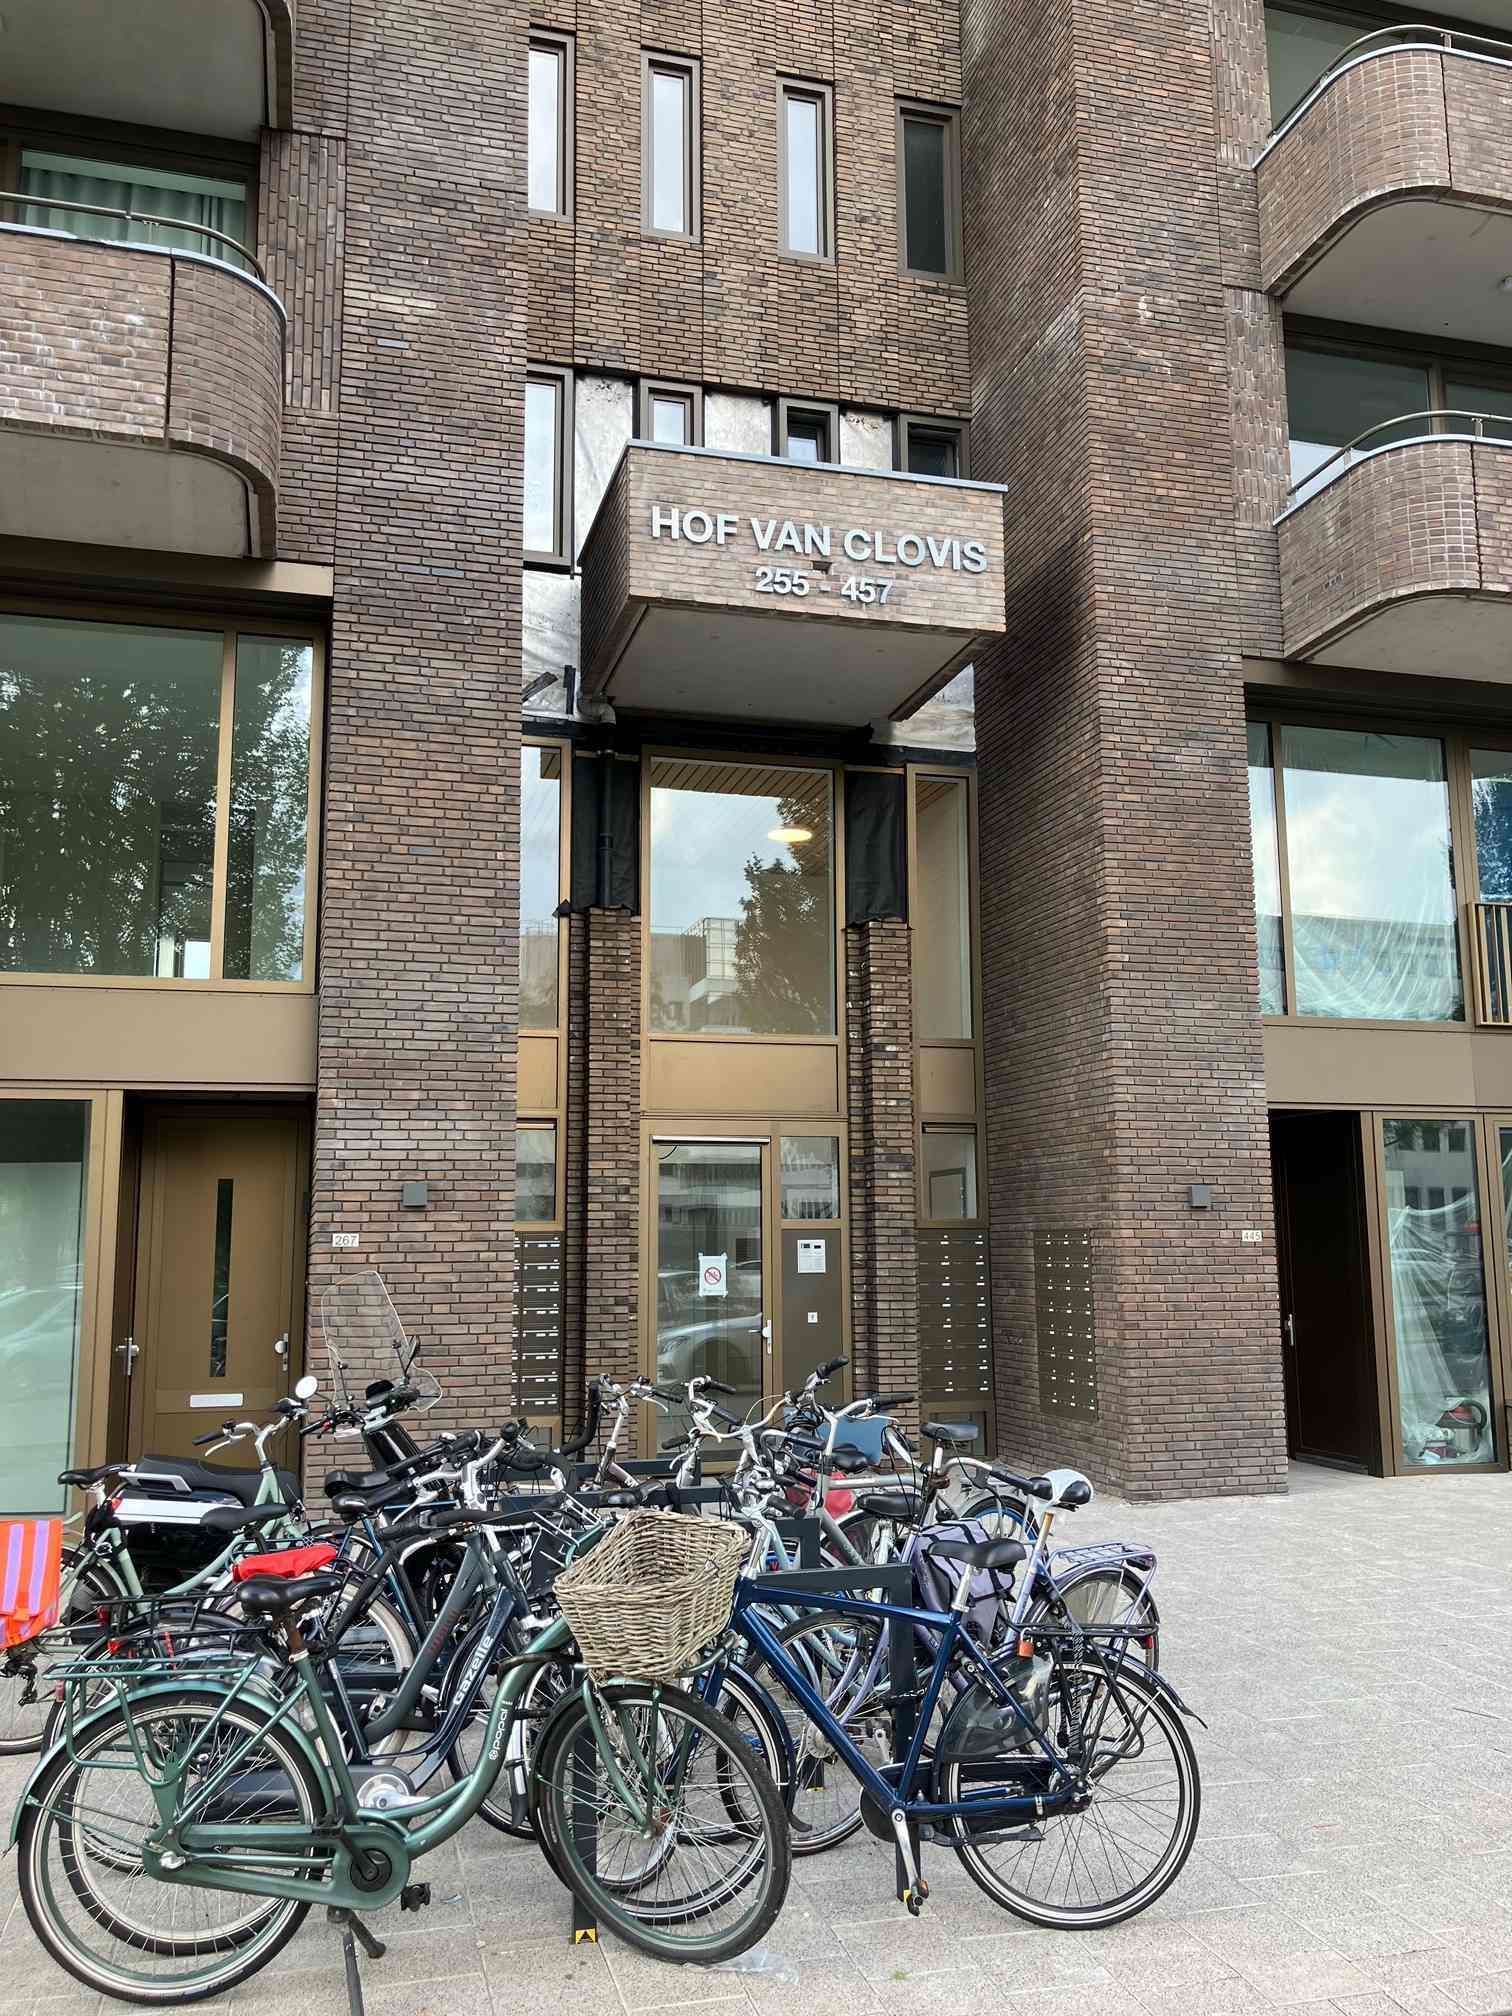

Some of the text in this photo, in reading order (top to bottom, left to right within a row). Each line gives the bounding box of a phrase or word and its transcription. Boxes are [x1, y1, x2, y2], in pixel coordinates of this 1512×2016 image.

[651, 505, 988, 573] HOF VAN CLOVIS
[755, 565, 810, 597] 255
[841, 576, 895, 604] 457
[335, 1235, 357, 1246] 267
[1243, 1232, 1261, 1240] 445
[453, 1635, 494, 1705] Gazelle
